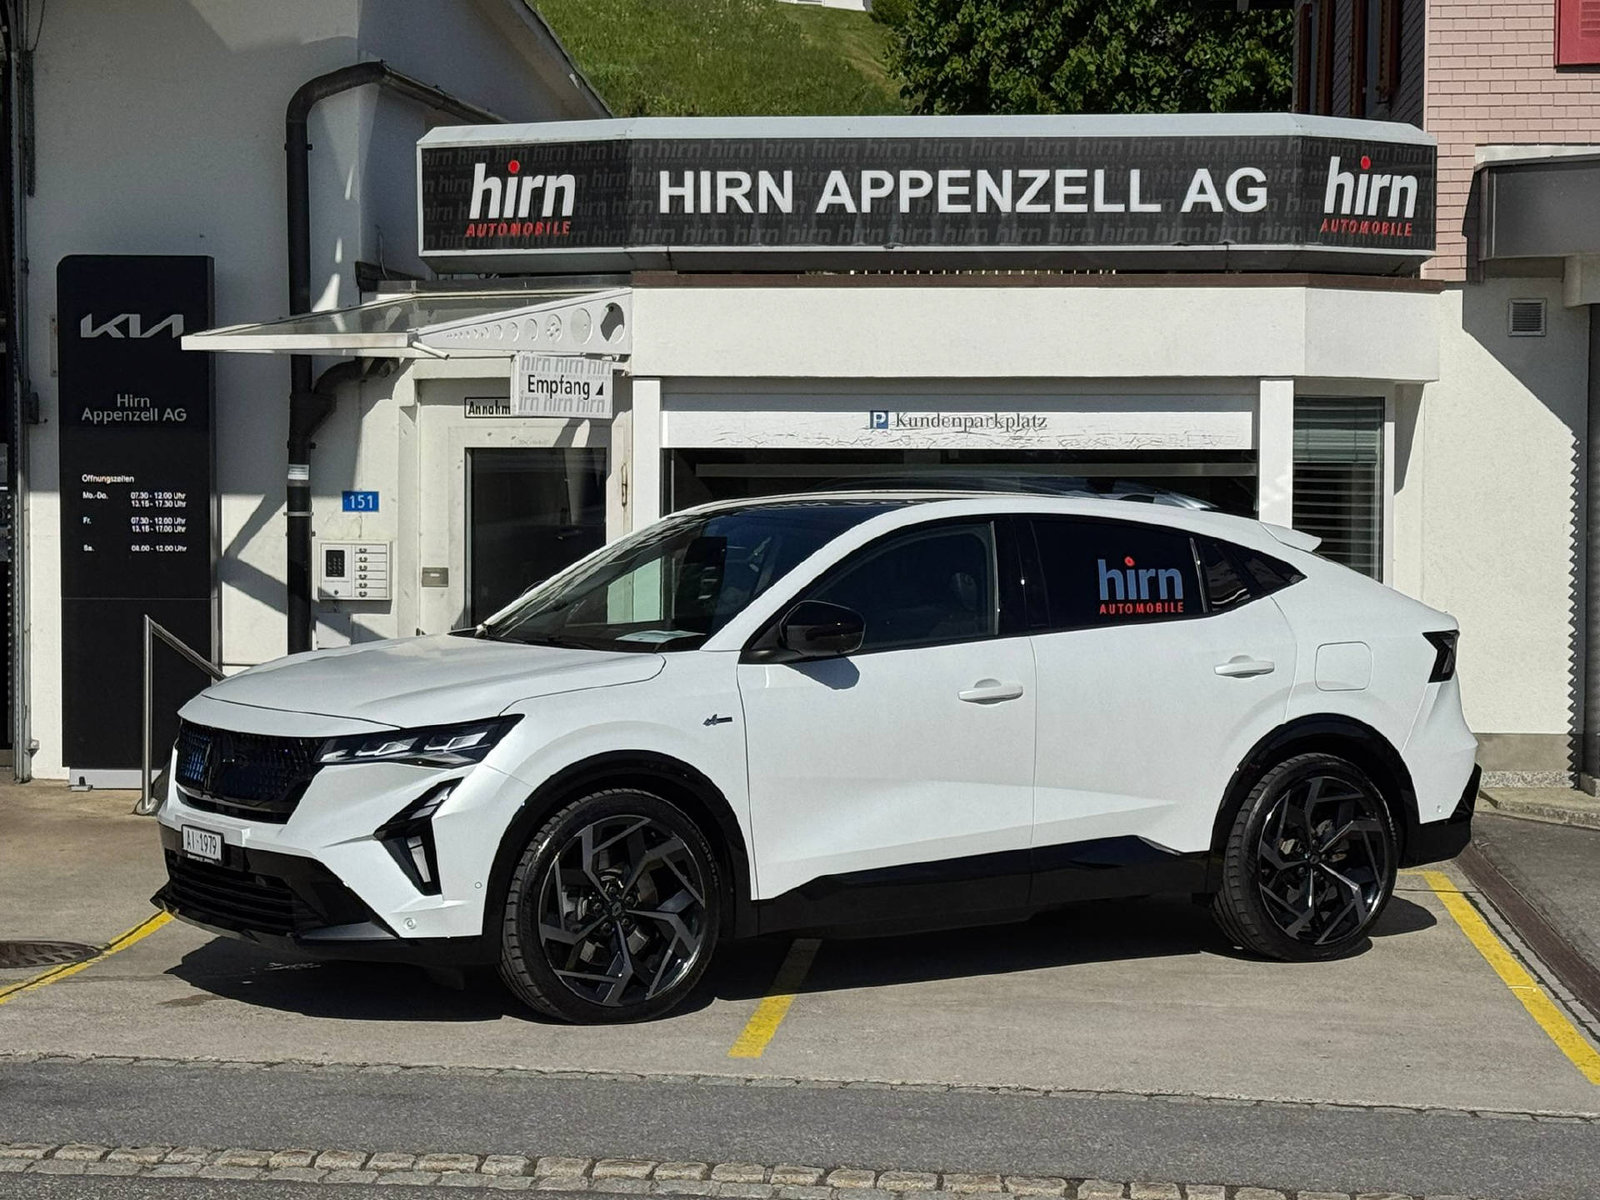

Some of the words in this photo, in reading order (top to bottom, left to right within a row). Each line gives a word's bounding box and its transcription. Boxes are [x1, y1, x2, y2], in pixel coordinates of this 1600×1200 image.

[469, 159, 576, 219] hirn
[658, 169, 794, 214] HIRN
[815, 168, 1162, 214] APPENZELL
[1180, 166, 1268, 214] AG
[1323, 155, 1418, 218] hirn
[465, 220, 572, 238] AUTOMOBILE
[1319, 218, 1413, 237] AUTOMOBILE
[527, 374, 590, 400] Empfang
[116, 393, 150, 408] Hirn
[81, 407, 158, 424] Appenzell
[162, 407, 187, 422] AG
[895, 412, 1048, 433] Kundenparkplatz
[173, 491, 186, 499] Uhr
[349, 495, 374, 509] 151
[1097, 556, 1184, 601] hirn
[1099, 601, 1184, 615] AUTOMOBILE
